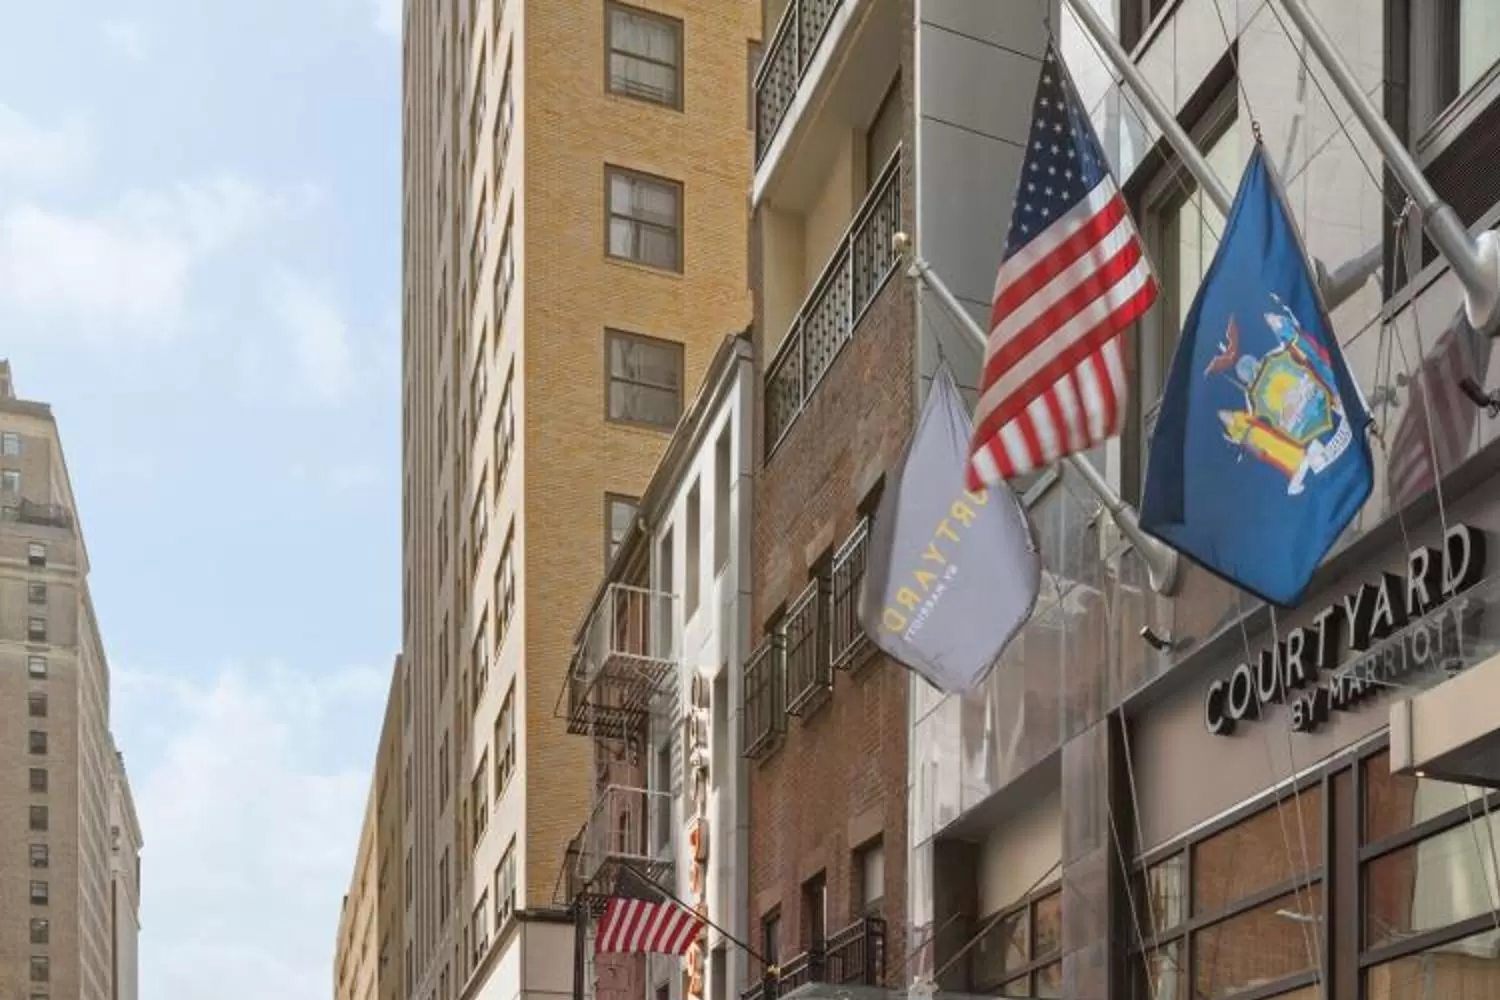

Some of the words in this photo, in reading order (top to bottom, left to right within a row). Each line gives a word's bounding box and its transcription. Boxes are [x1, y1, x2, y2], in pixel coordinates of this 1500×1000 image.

[1205, 522, 1473, 734] COURTYARD
[1291, 686, 1318, 731] BY
[1327, 598, 1469, 710] MARRIOTT
